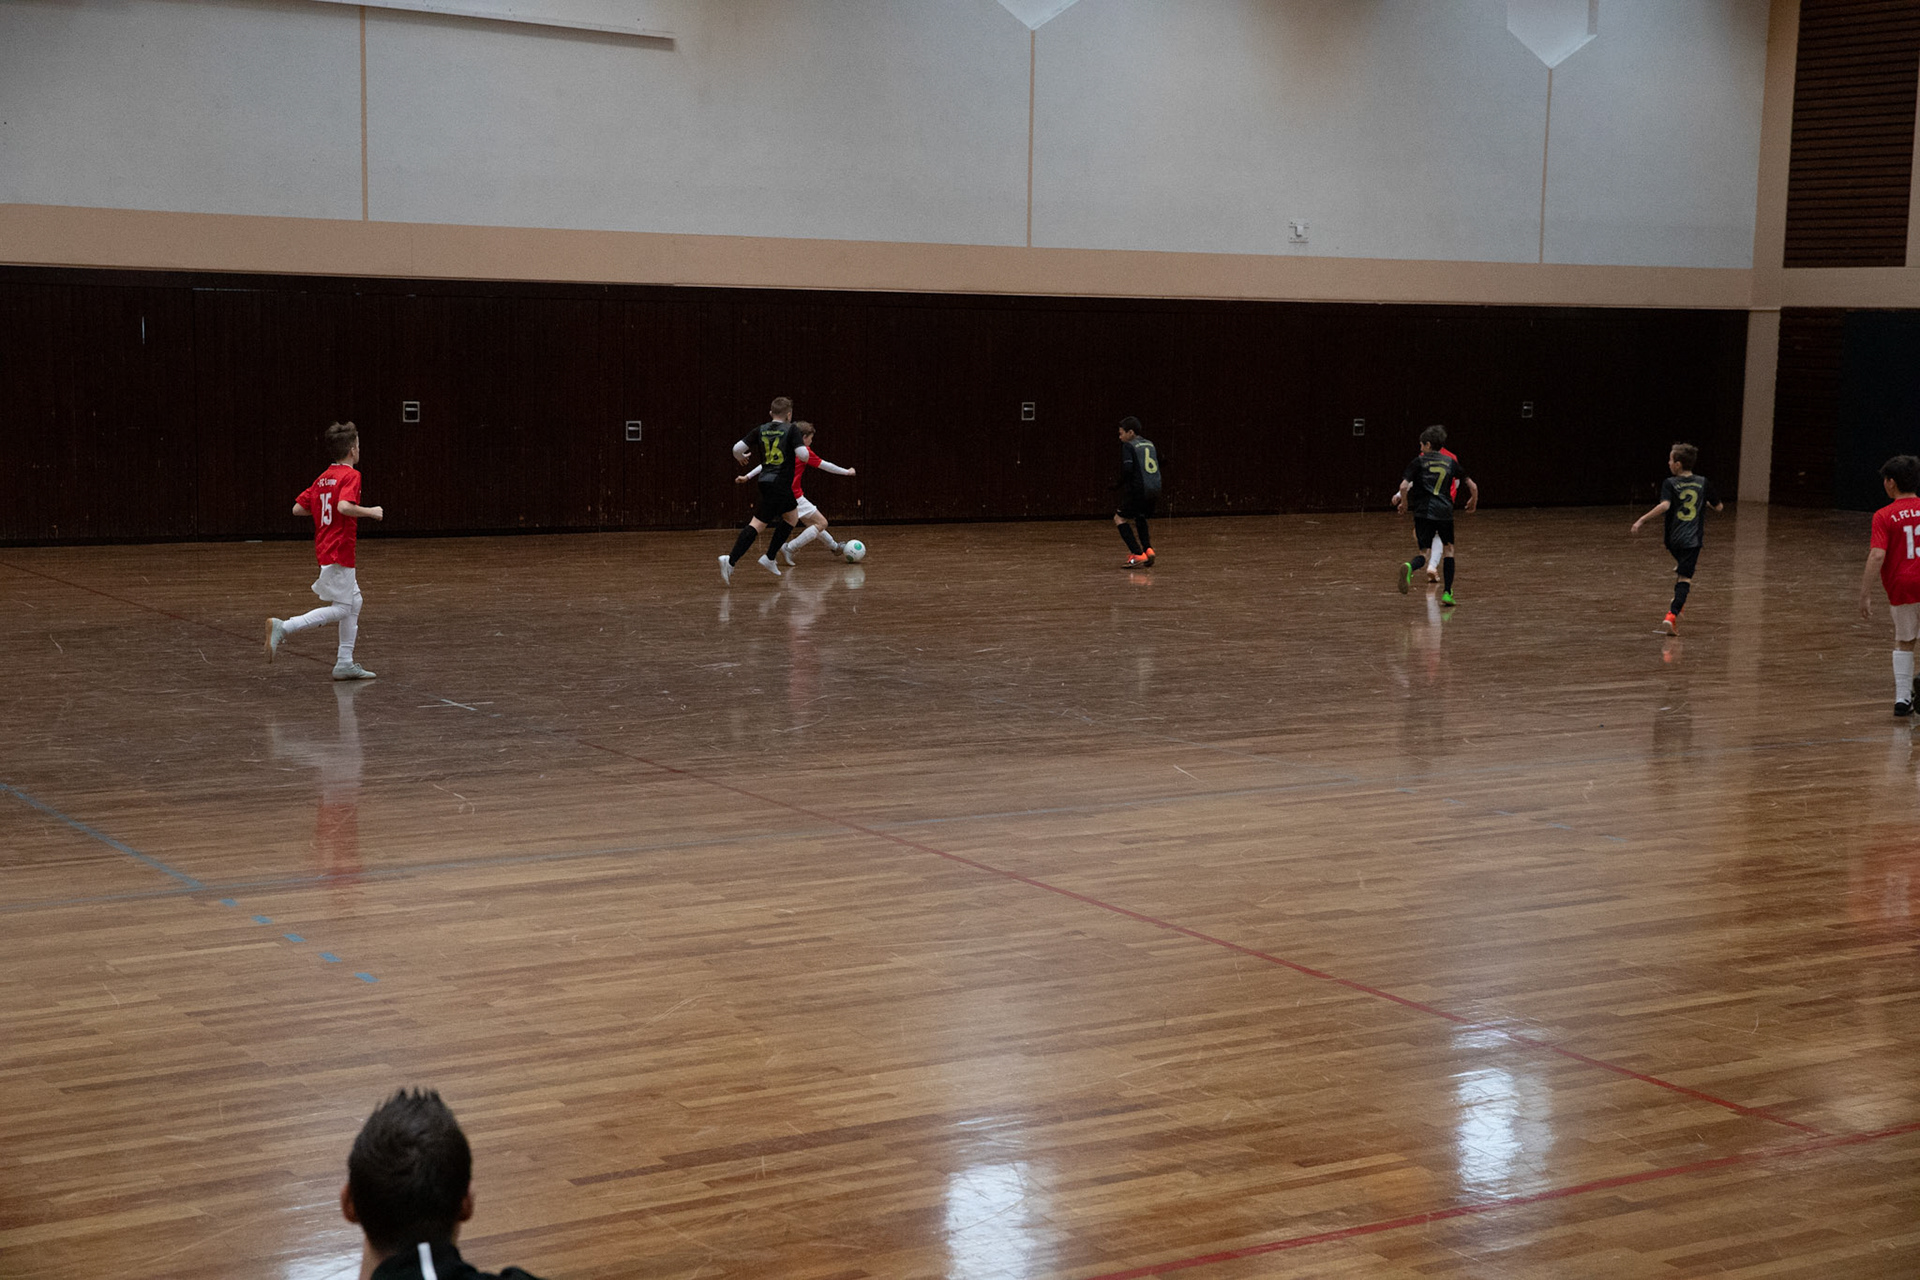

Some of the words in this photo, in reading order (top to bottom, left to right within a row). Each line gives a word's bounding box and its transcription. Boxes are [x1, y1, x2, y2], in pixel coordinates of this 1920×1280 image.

[761, 436, 784, 465] 16
[1145, 447, 1157, 474] 6
[1429, 466, 1446, 495] 7
[320, 492, 332, 526] 15
[1677, 489, 1697, 521] 3
[1899, 509, 1910, 519] FC
